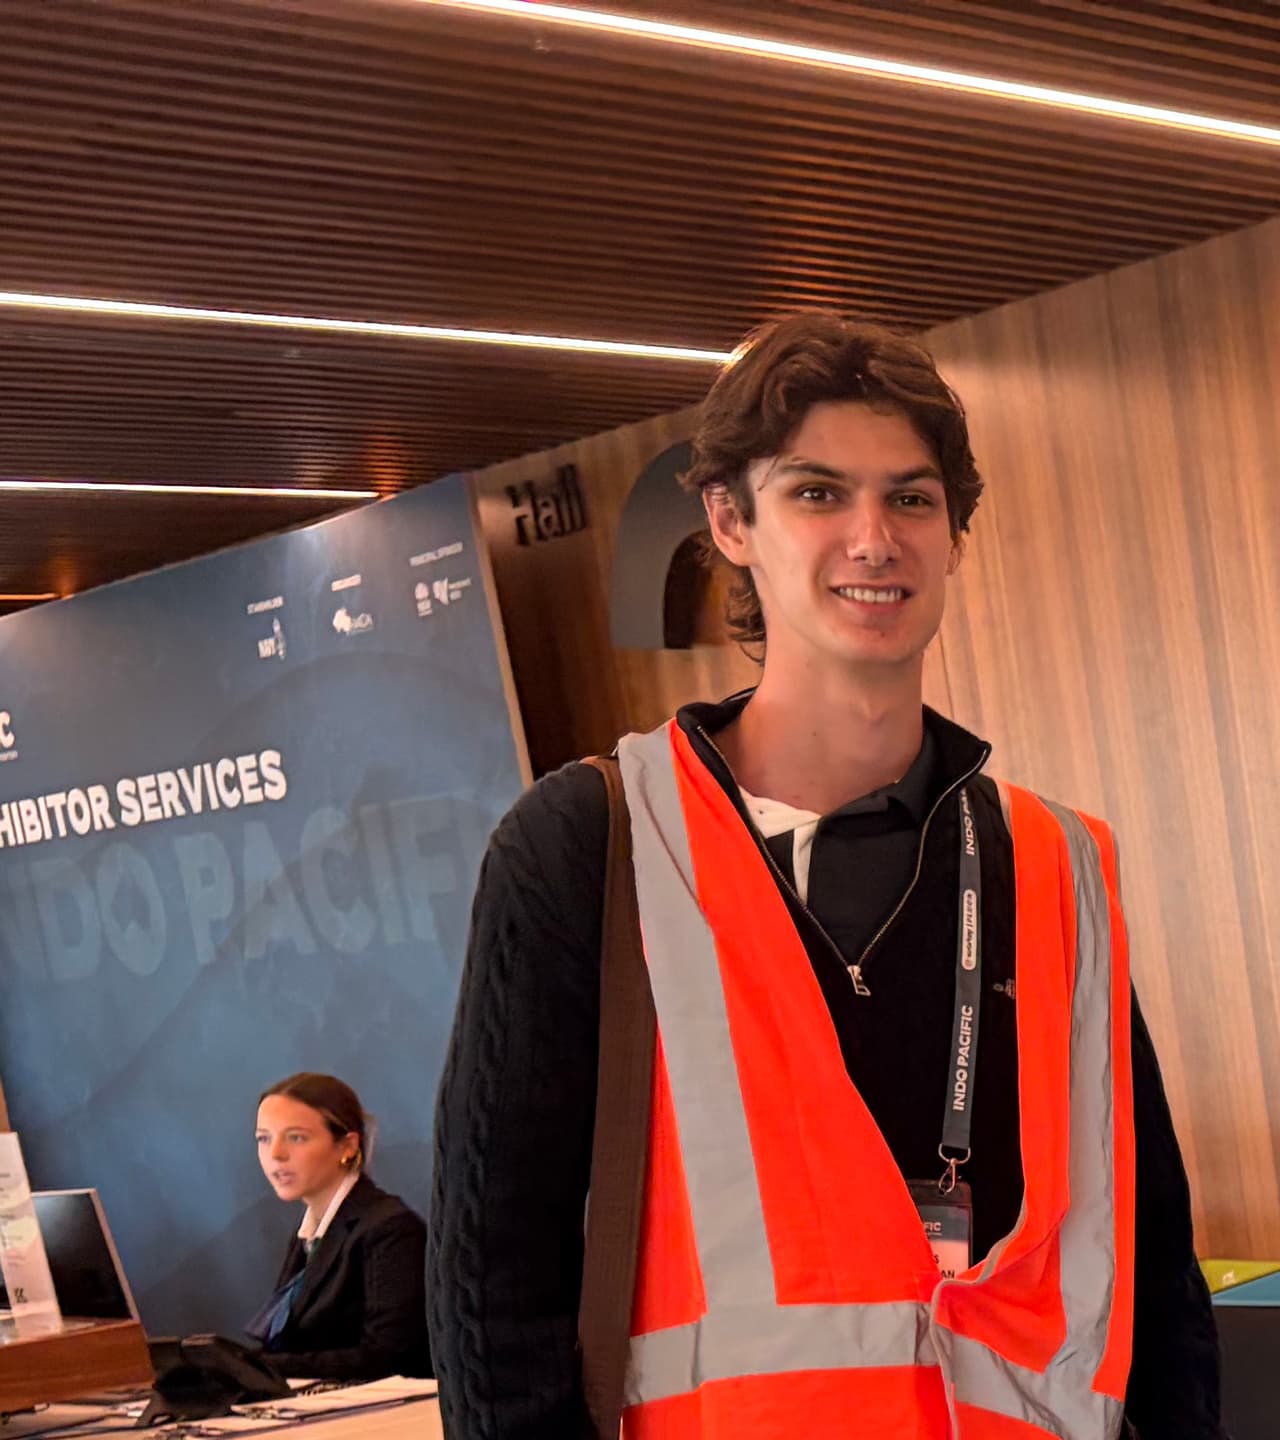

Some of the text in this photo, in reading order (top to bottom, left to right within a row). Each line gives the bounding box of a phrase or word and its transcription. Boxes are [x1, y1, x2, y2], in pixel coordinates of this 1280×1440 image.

[505, 464, 588, 547] Hall
[116, 749, 287, 827] SERVICES
[953, 1004, 974, 1111] INDO PACIFIC
